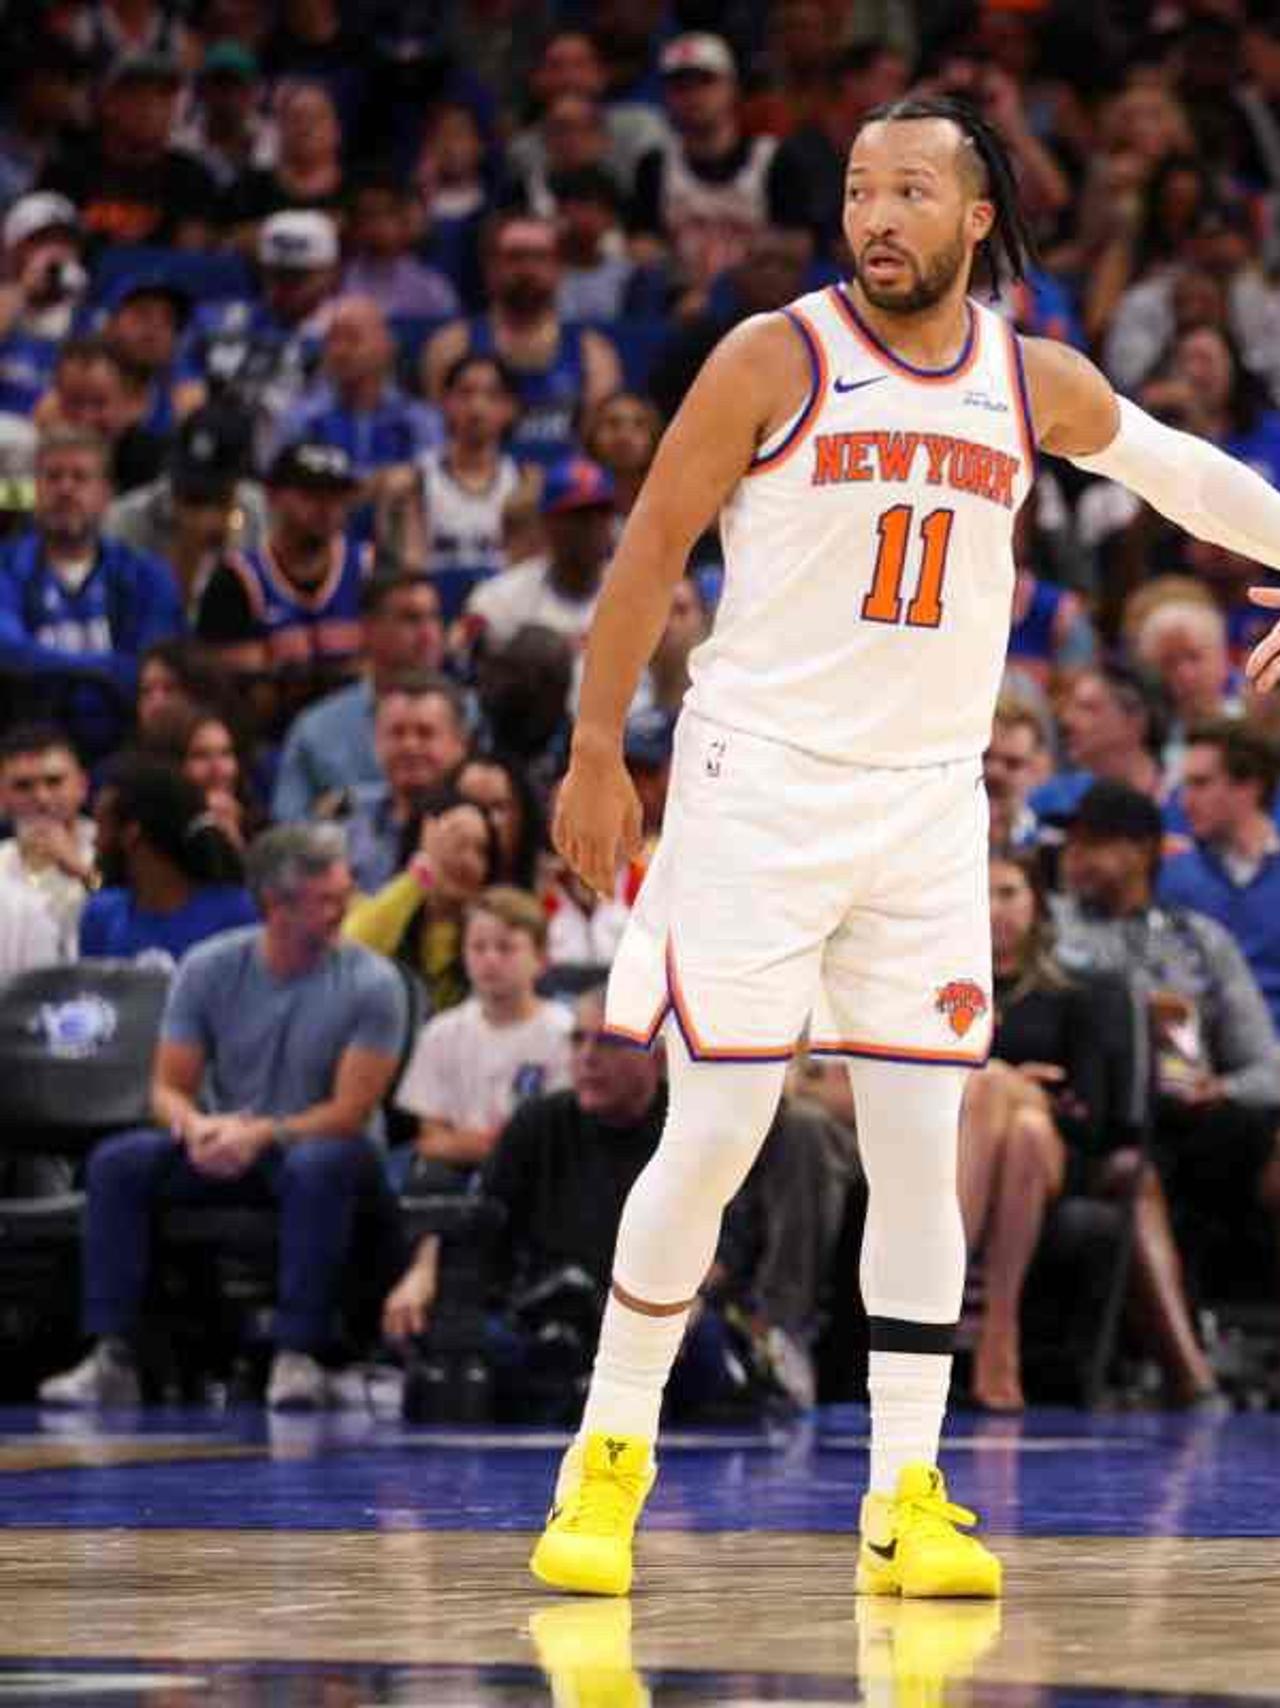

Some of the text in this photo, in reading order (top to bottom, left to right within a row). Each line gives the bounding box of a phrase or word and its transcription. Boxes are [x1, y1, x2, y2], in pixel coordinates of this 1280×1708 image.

[812, 430, 1021, 511] NEW YORK
[860, 502, 955, 628] 11
